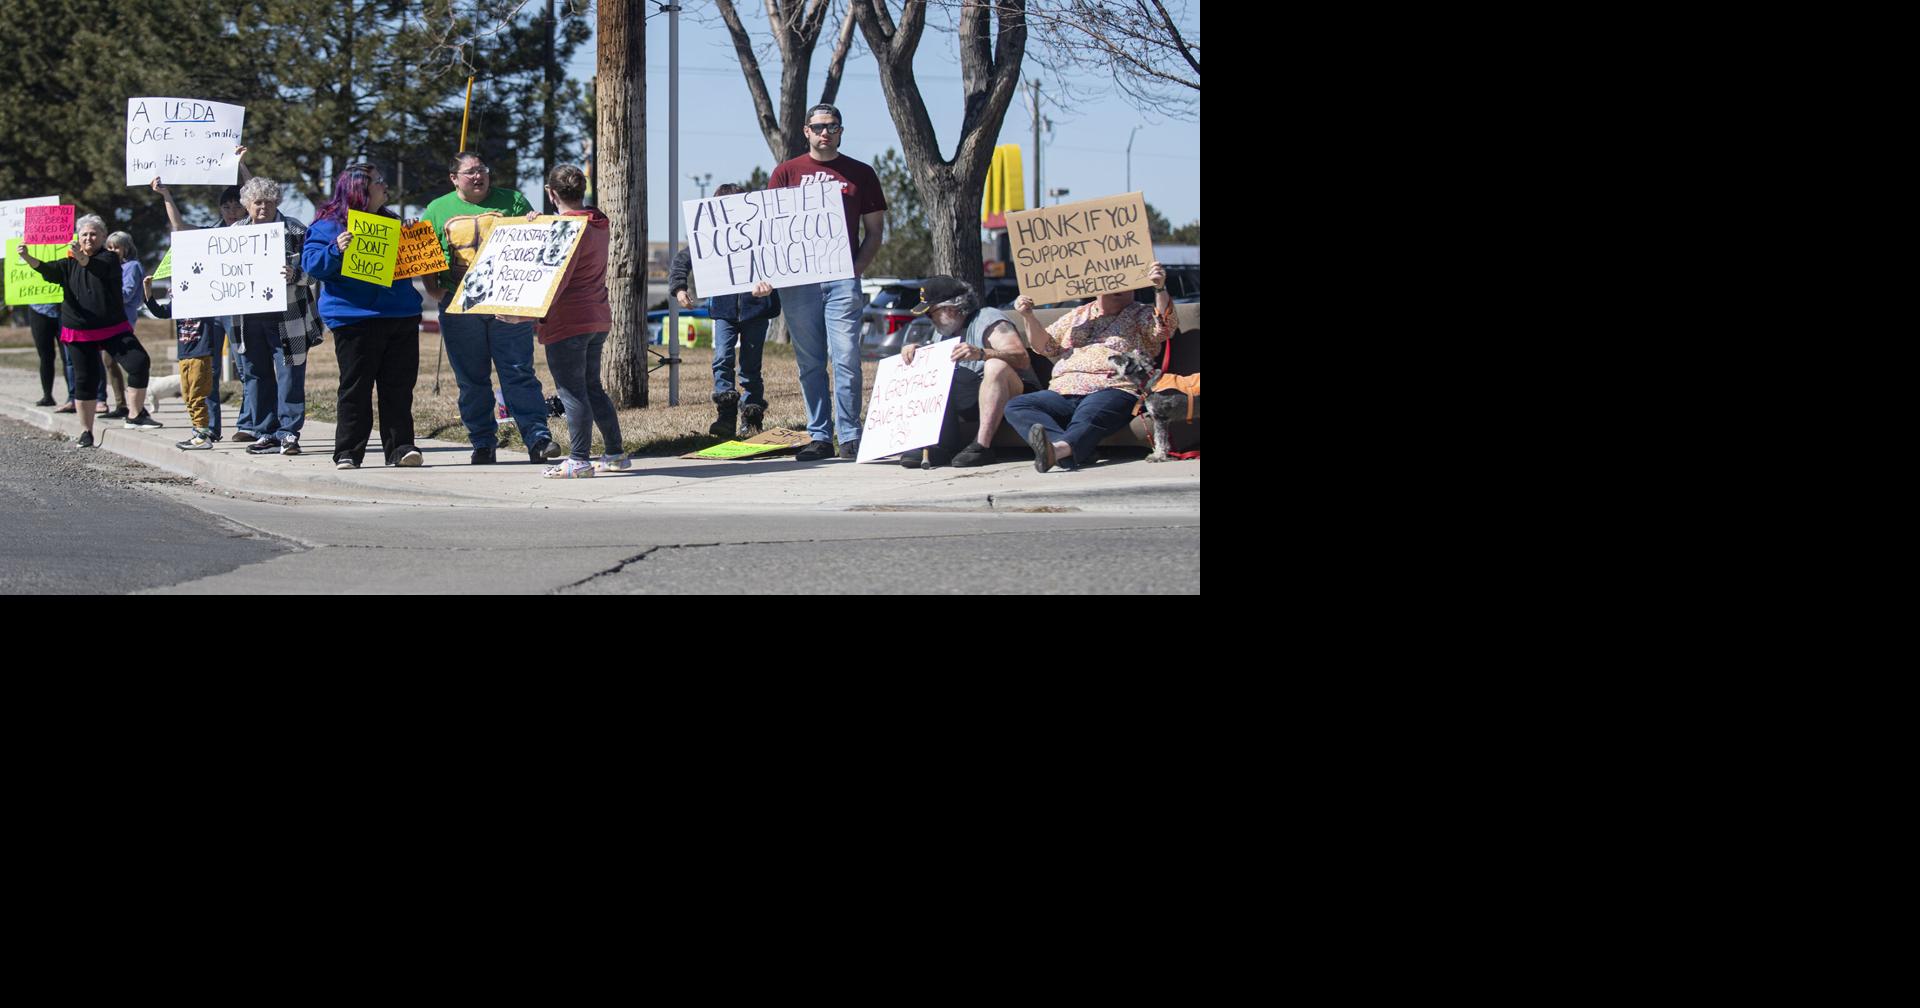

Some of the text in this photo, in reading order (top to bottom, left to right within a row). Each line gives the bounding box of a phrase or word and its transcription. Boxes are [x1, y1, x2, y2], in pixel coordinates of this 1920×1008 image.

[132, 101, 215, 123] A USDA
[129, 126, 240, 145] CAGE is smaller
[132, 152, 224, 172] than this sign!
[693, 197, 735, 232] ARE
[1016, 203, 1138, 246] HONK IF YOU
[59, 224, 71, 233] BY
[353, 219, 393, 237] ADOPT
[490, 228, 509, 243] MY
[758, 215, 790, 246] NOT
[789, 212, 844, 244] GOOD
[1017, 230, 1140, 267] SUPPORT YOUR
[348, 253, 384, 275] SHOP
[496, 264, 543, 282] RESCUED
[1025, 254, 1145, 289] LOCAL ANIMAL
[1065, 272, 1129, 297] SHELTER
